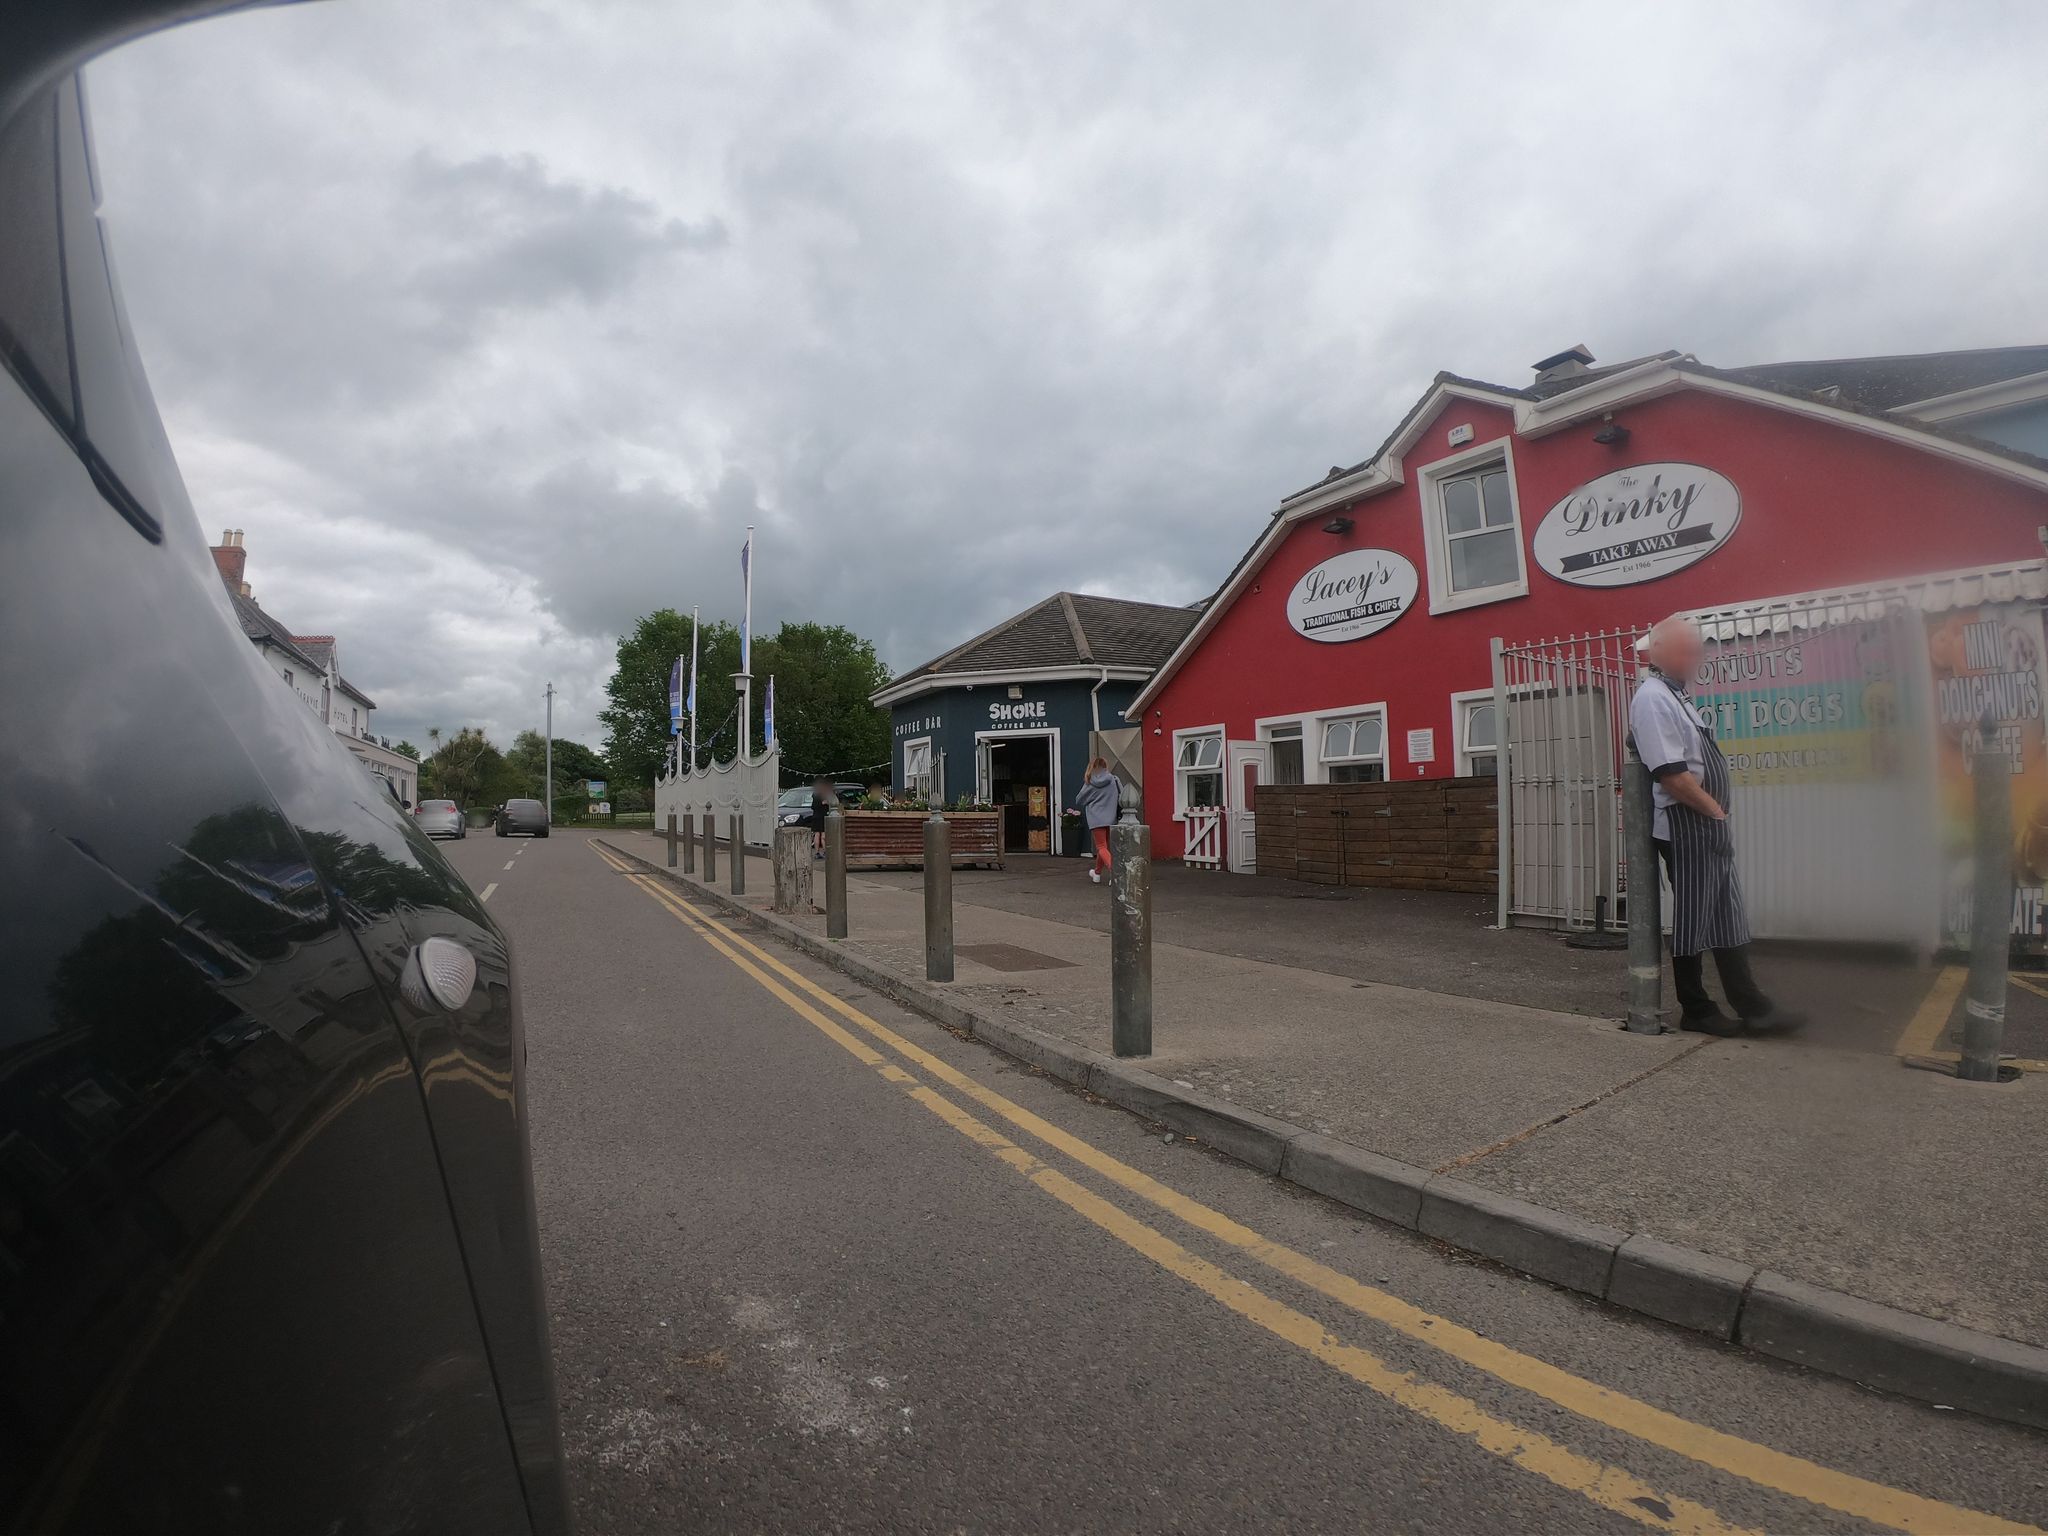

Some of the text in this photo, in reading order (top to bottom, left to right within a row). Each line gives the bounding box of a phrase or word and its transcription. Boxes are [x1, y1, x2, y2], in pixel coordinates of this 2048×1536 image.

[1618, 476, 1639, 489] The
[1562, 474, 1706, 537] Dinky
[1589, 533, 1679, 565] TAKE AWAY
[1622, 560, 1652, 573] Est 1966
[1302, 560, 1396, 605] Lacey's
[1306, 599, 1398, 628] TRADITIONAL FISH & CHIPS
[1964, 621, 2002, 669] MINI
[1694, 646, 1803, 686] ONUTS
[988, 700, 1047, 722] SHORE
[1694, 692, 1845, 732] OT DOGS
[1938, 669, 2040, 725] DOUGHNUTS
[895, 716, 942, 737] COFFEE BAR
